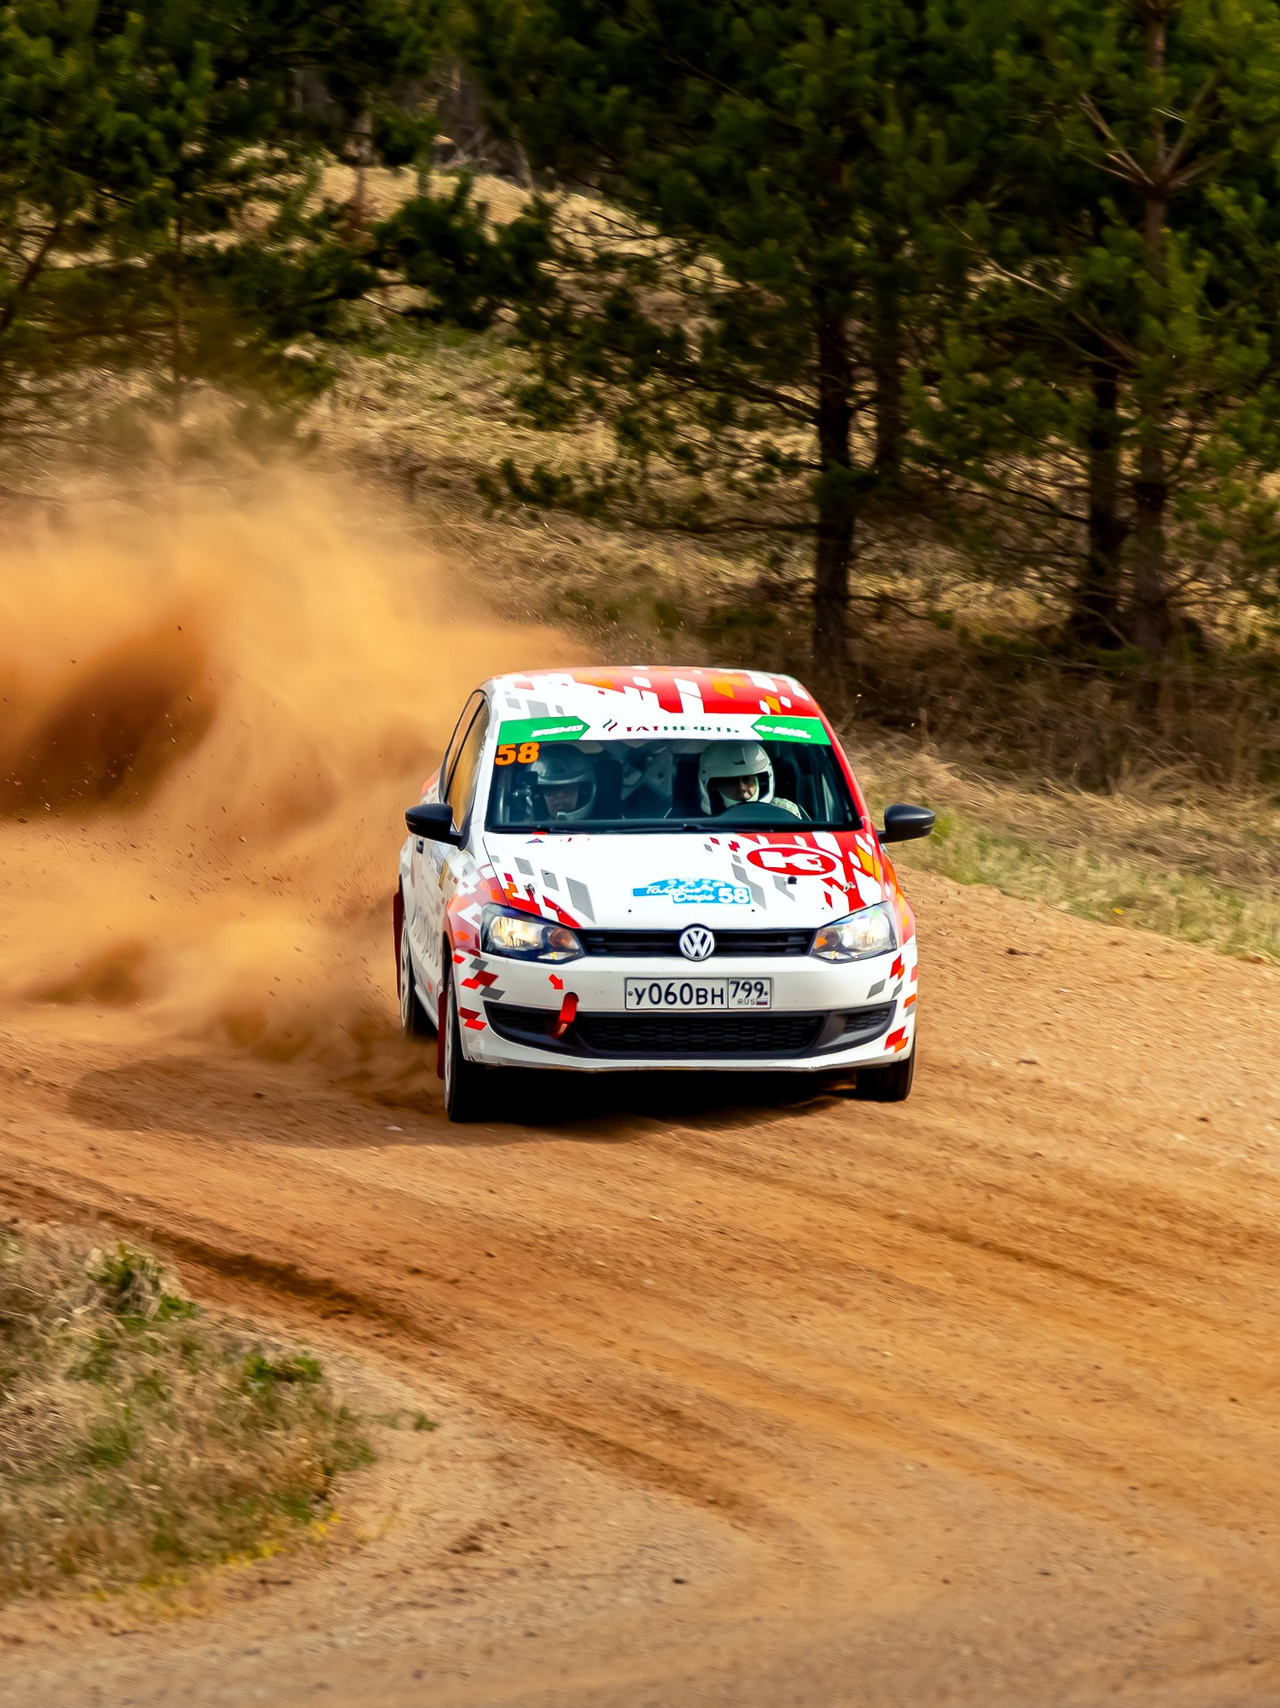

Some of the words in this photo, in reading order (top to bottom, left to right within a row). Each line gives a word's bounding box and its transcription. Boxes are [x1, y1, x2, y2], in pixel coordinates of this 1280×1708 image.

[494, 741, 541, 766] 58
[718, 887, 750, 904] 58
[729, 981, 764, 998] 799
